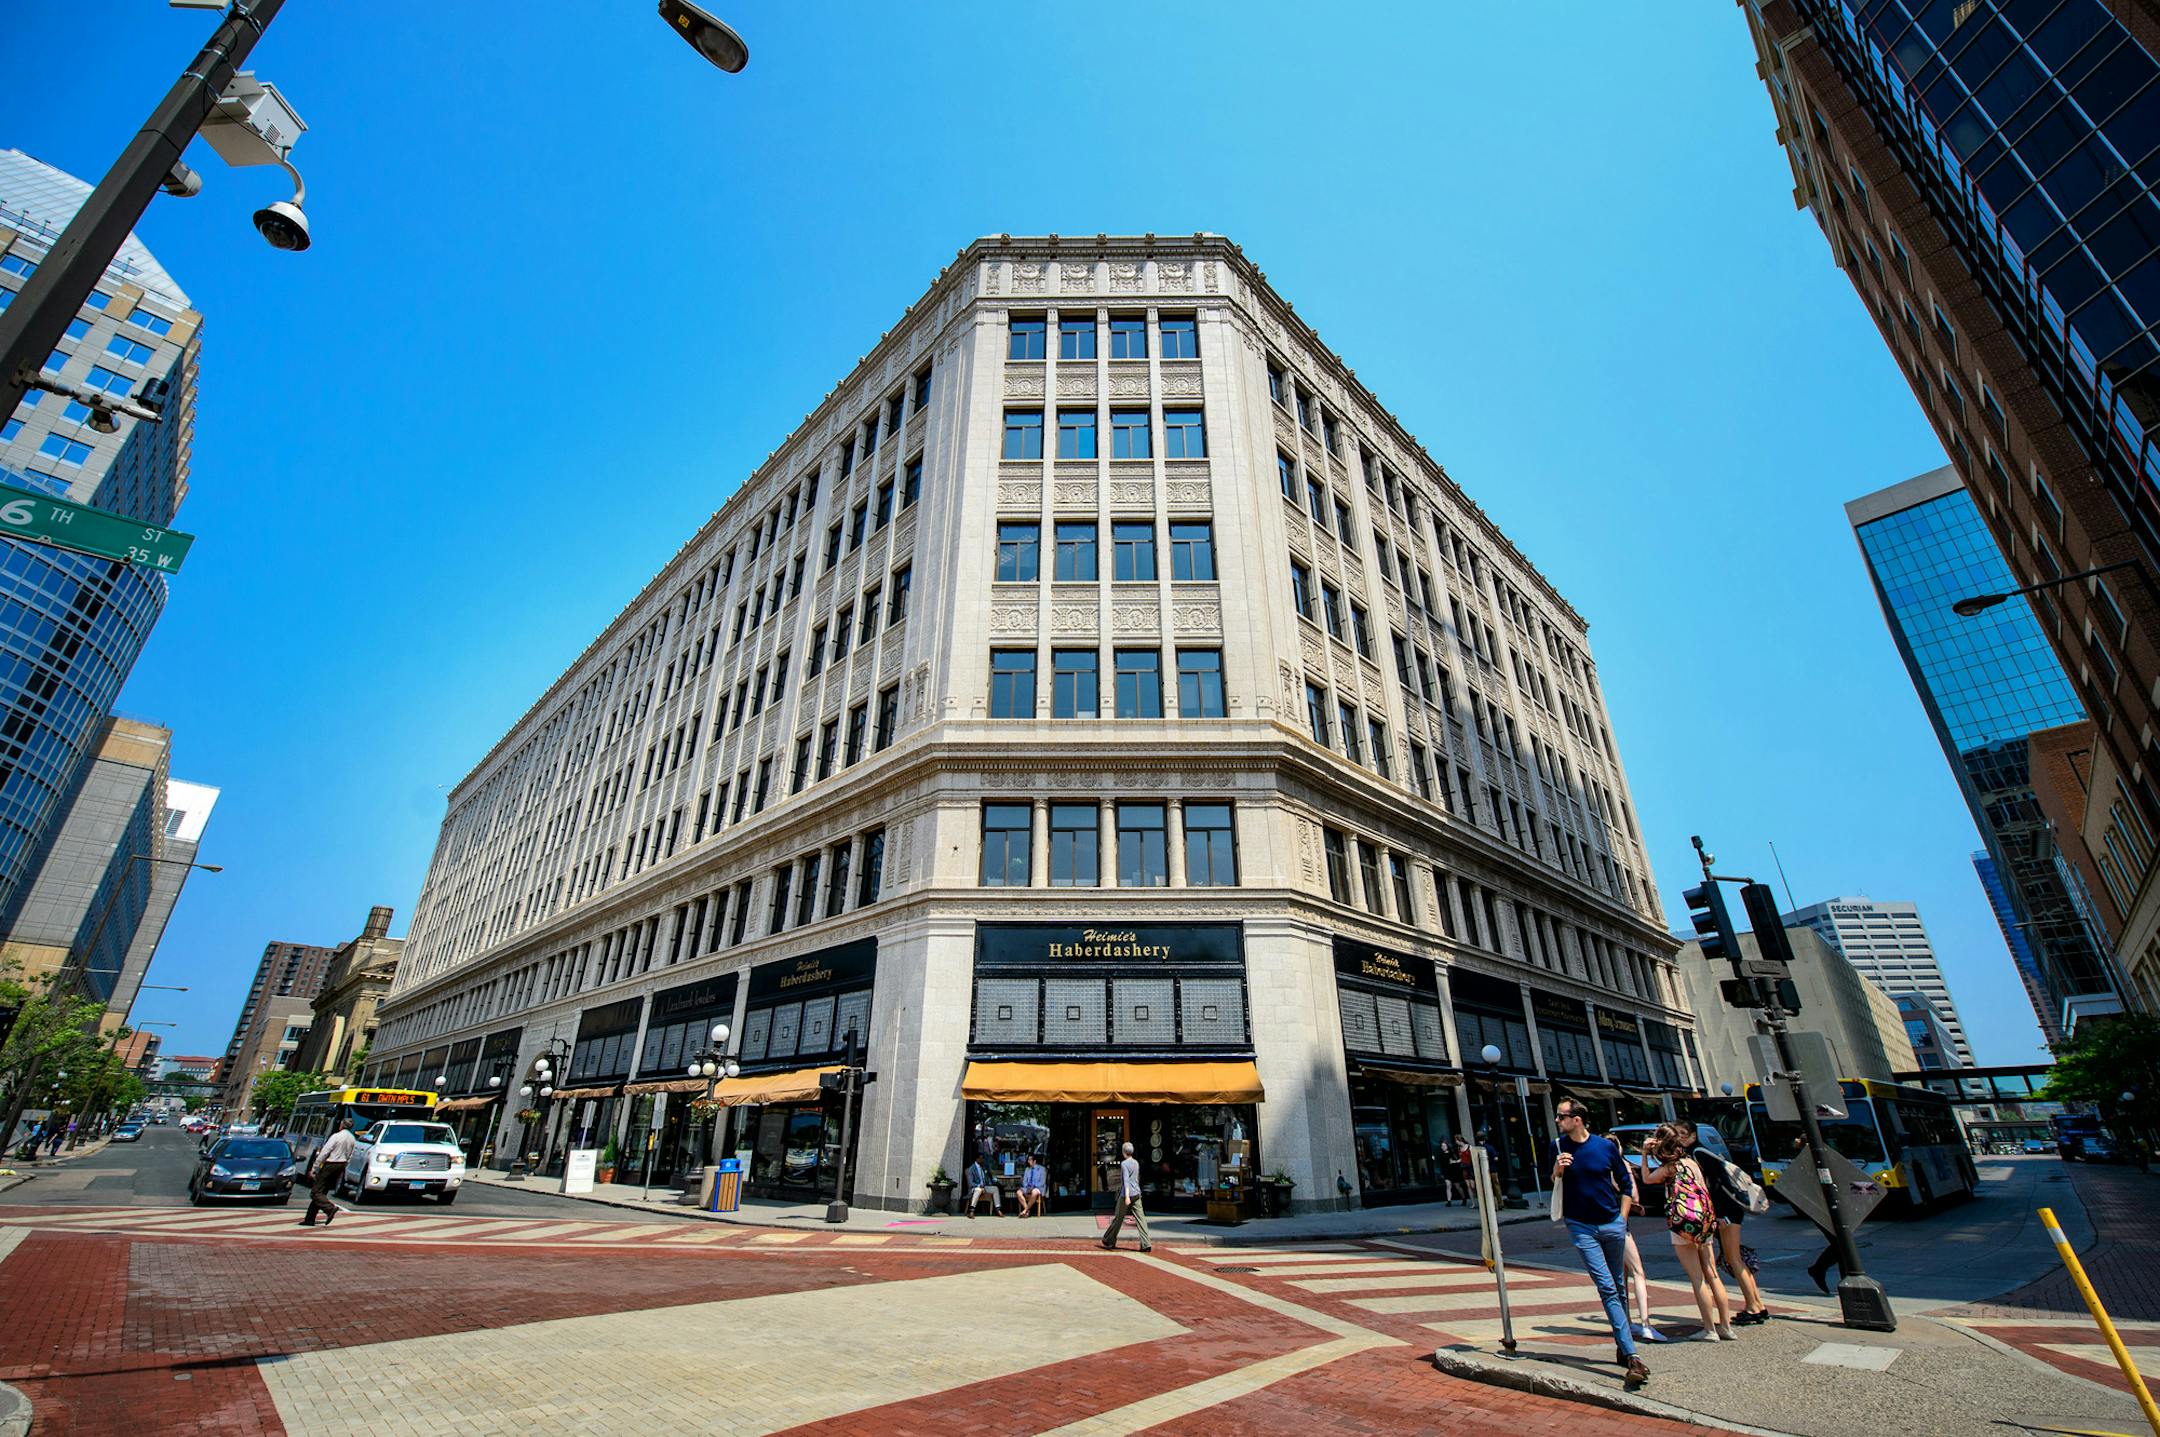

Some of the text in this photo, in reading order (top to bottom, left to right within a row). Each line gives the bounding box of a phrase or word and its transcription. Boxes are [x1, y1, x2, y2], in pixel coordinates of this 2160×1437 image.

[0, 499, 166, 543] 6 TH ST
[125, 546, 174, 568] 35 W
[1831, 904, 1874, 912] SECURIAN
[1083, 928, 1137, 942] Heimie's
[1049, 943, 1171, 960] Haberdashery
[361, 1093, 370, 1103] 61
